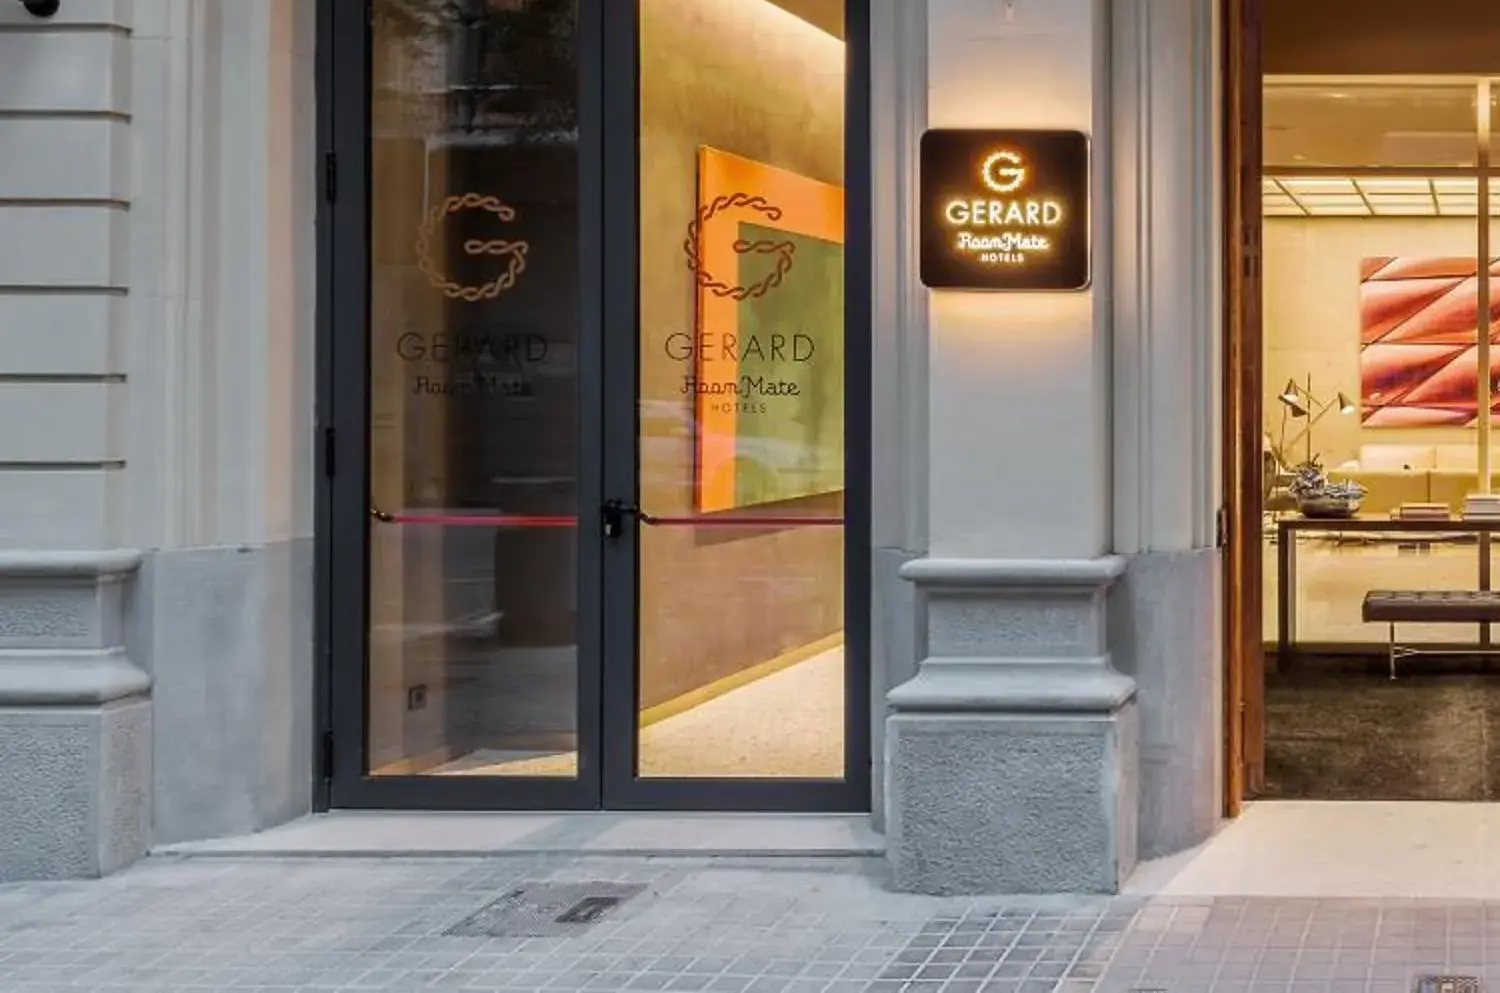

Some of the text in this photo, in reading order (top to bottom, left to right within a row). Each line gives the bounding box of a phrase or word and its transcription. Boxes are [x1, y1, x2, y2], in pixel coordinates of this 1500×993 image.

[982, 150, 1026, 193] G
[944, 199, 1064, 225] GERARD
[980, 253, 1025, 263] HOTELS
[396, 331, 548, 362] GERARD
[664, 332, 816, 362] GERARD
[710, 401, 768, 414] HOTELS
